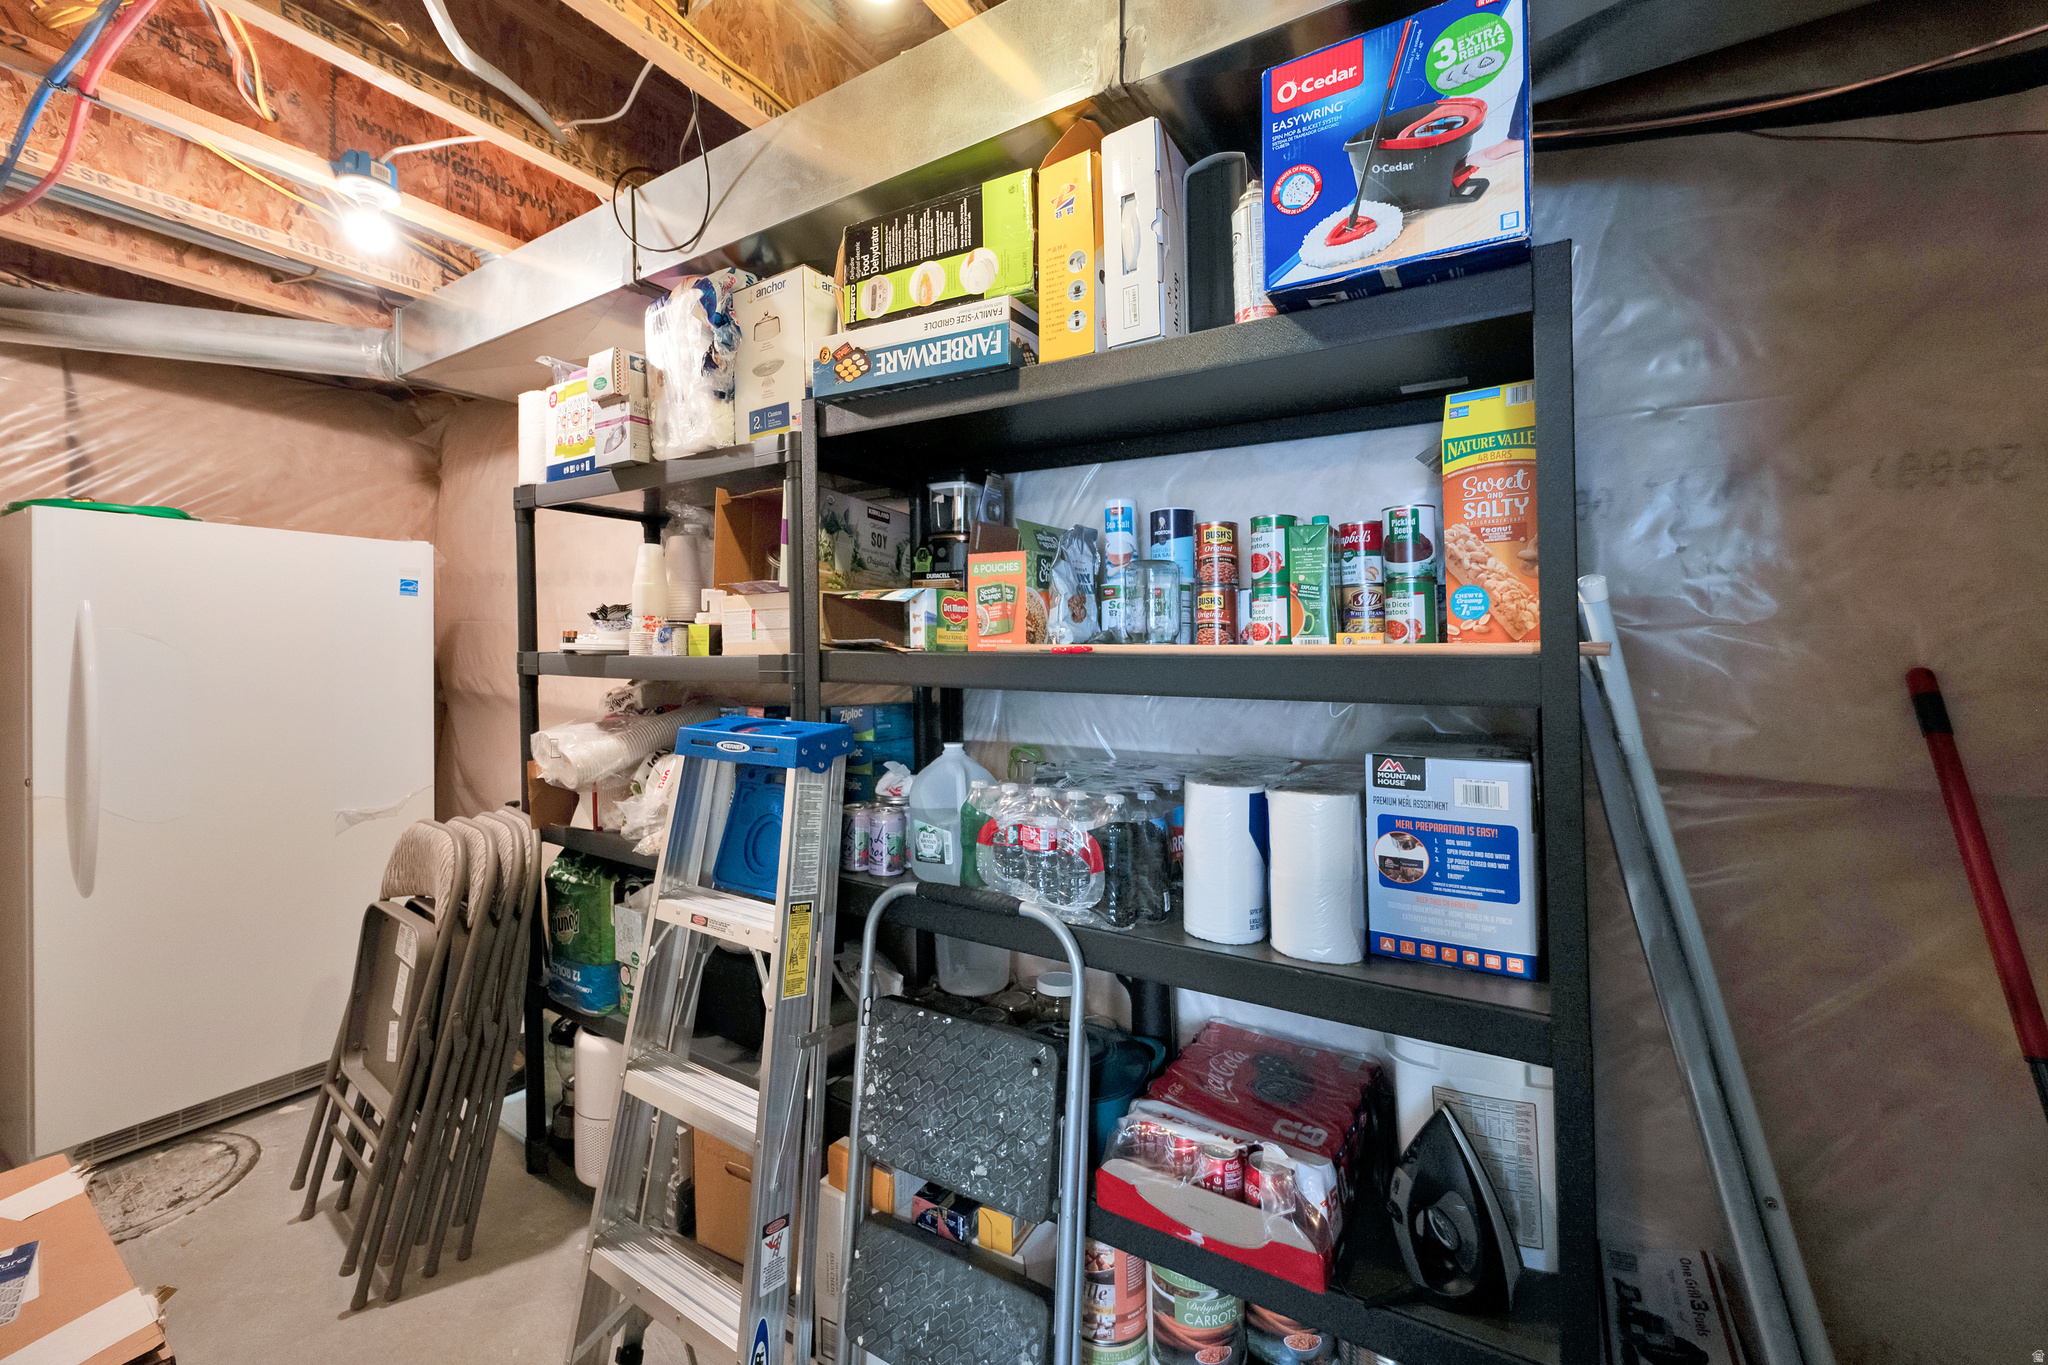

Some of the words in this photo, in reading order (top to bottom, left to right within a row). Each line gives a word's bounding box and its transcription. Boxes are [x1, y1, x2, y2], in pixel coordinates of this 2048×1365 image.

[1469, 20, 1499, 35] includes
[1457, 23, 1505, 52] EXTRA
[644, 15, 733, 91] 13132-R
[1433, 38, 1457, 69] 3
[1458, 34, 1506, 62] REFILLS
[281, 1, 422, 88] ESR-1153
[450, 90, 505, 130] CCMC
[522, 129, 605, 180] 13132-R
[1277, 64, 1357, 103] O-Cedar
[1272, 101, 1343, 133] EASYWRING
[1272, 133, 1283, 142] SPIN
[1284, 130, 1296, 138] MOP
[1302, 121, 1321, 132] BUCKET
[1322, 115, 1342, 126] SYSTEM
[1371, 161, 1414, 174] O-Cedar
[64, 164, 192, 213] ESR-1153
[216, 216, 271, 241] CCMC
[287, 237, 370, 273] 13132-R
[390, 271, 421, 291] HUD
[870, 226, 881, 273] Dehydrator
[862, 254, 870, 276] Food
[756, 279, 786, 299] anchor
[956, 307, 1003, 324] FAMILY-SIZE
[924, 318, 955, 331] GRIDDLE
[875, 330, 1002, 376] FARBERWARE
[753, 416, 760, 430] 2
[1447, 436, 1496, 460] NATURE
[1498, 431, 1536, 446] VALLE
[1478, 454, 1488, 462] 48
[1490, 450, 1512, 460] BARS
[1462, 469, 1530, 498] Sweet
[868, 507, 890, 520] KIRKLAND
[1463, 496, 1529, 520] SALTY
[1205, 530, 1232, 540] BUSH'S
[1480, 525, 1511, 533] Peanut
[871, 532, 888, 549] SOY
[1341, 530, 1370, 546] mpbell's
[980, 562, 1019, 573] POUCHES
[979, 593, 1001, 602] Change
[1198, 597, 1222, 606] BUSH'S
[943, 603, 952, 611] Del
[953, 604, 968, 612] Monte
[840, 709, 863, 723] Ziploc
[723, 742, 743, 750] WERNER
[1377, 772, 1420, 781] MOUNTAIN
[1377, 778, 1405, 786] HOUSE
[1373, 796, 1397, 806] PREMIUM
[1398, 798, 1412, 808] MEAL
[1413, 800, 1448, 811] ASSORTMENT
[1395, 819, 1414, 830] MEAL
[1415, 821, 1465, 835] PREPARATION
[1467, 826, 1475, 836] IS
[1476, 828, 1498, 838] EASY!
[1454, 858, 1469, 866] POUCH
[1474, 850, 1484, 858] AND
[1450, 900, 1465, 908] HAND
[1679, 1258, 1692, 1277] One
[1685, 1279, 1702, 1299] Grill
[1690, 1300, 1709, 1312] 3
[1184, 1306, 1237, 1326] CARROTS
[1693, 1311, 1711, 1337] Fuels
